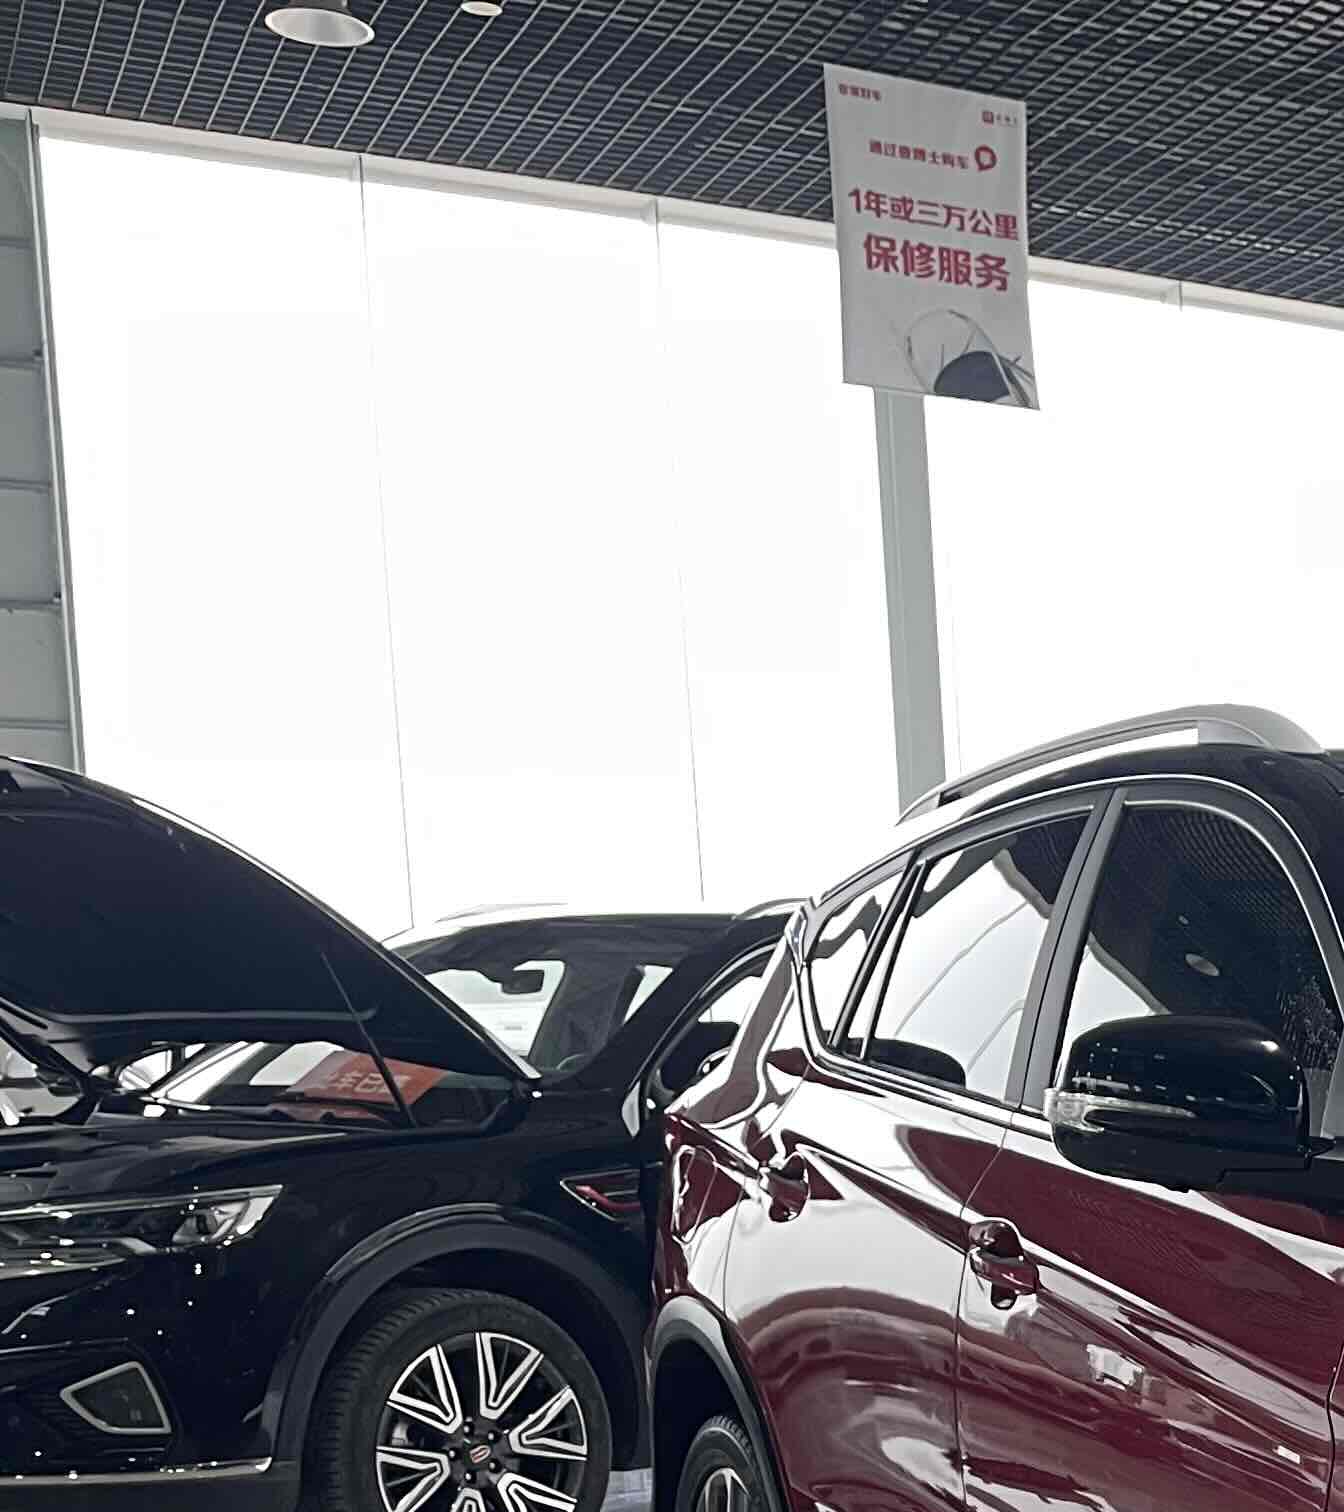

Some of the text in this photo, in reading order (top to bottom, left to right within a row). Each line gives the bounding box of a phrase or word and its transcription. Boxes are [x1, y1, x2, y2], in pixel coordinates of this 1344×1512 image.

[848, 188, 1019, 241] 1年或三万公里
[863, 232, 1011, 292] 保修服务
